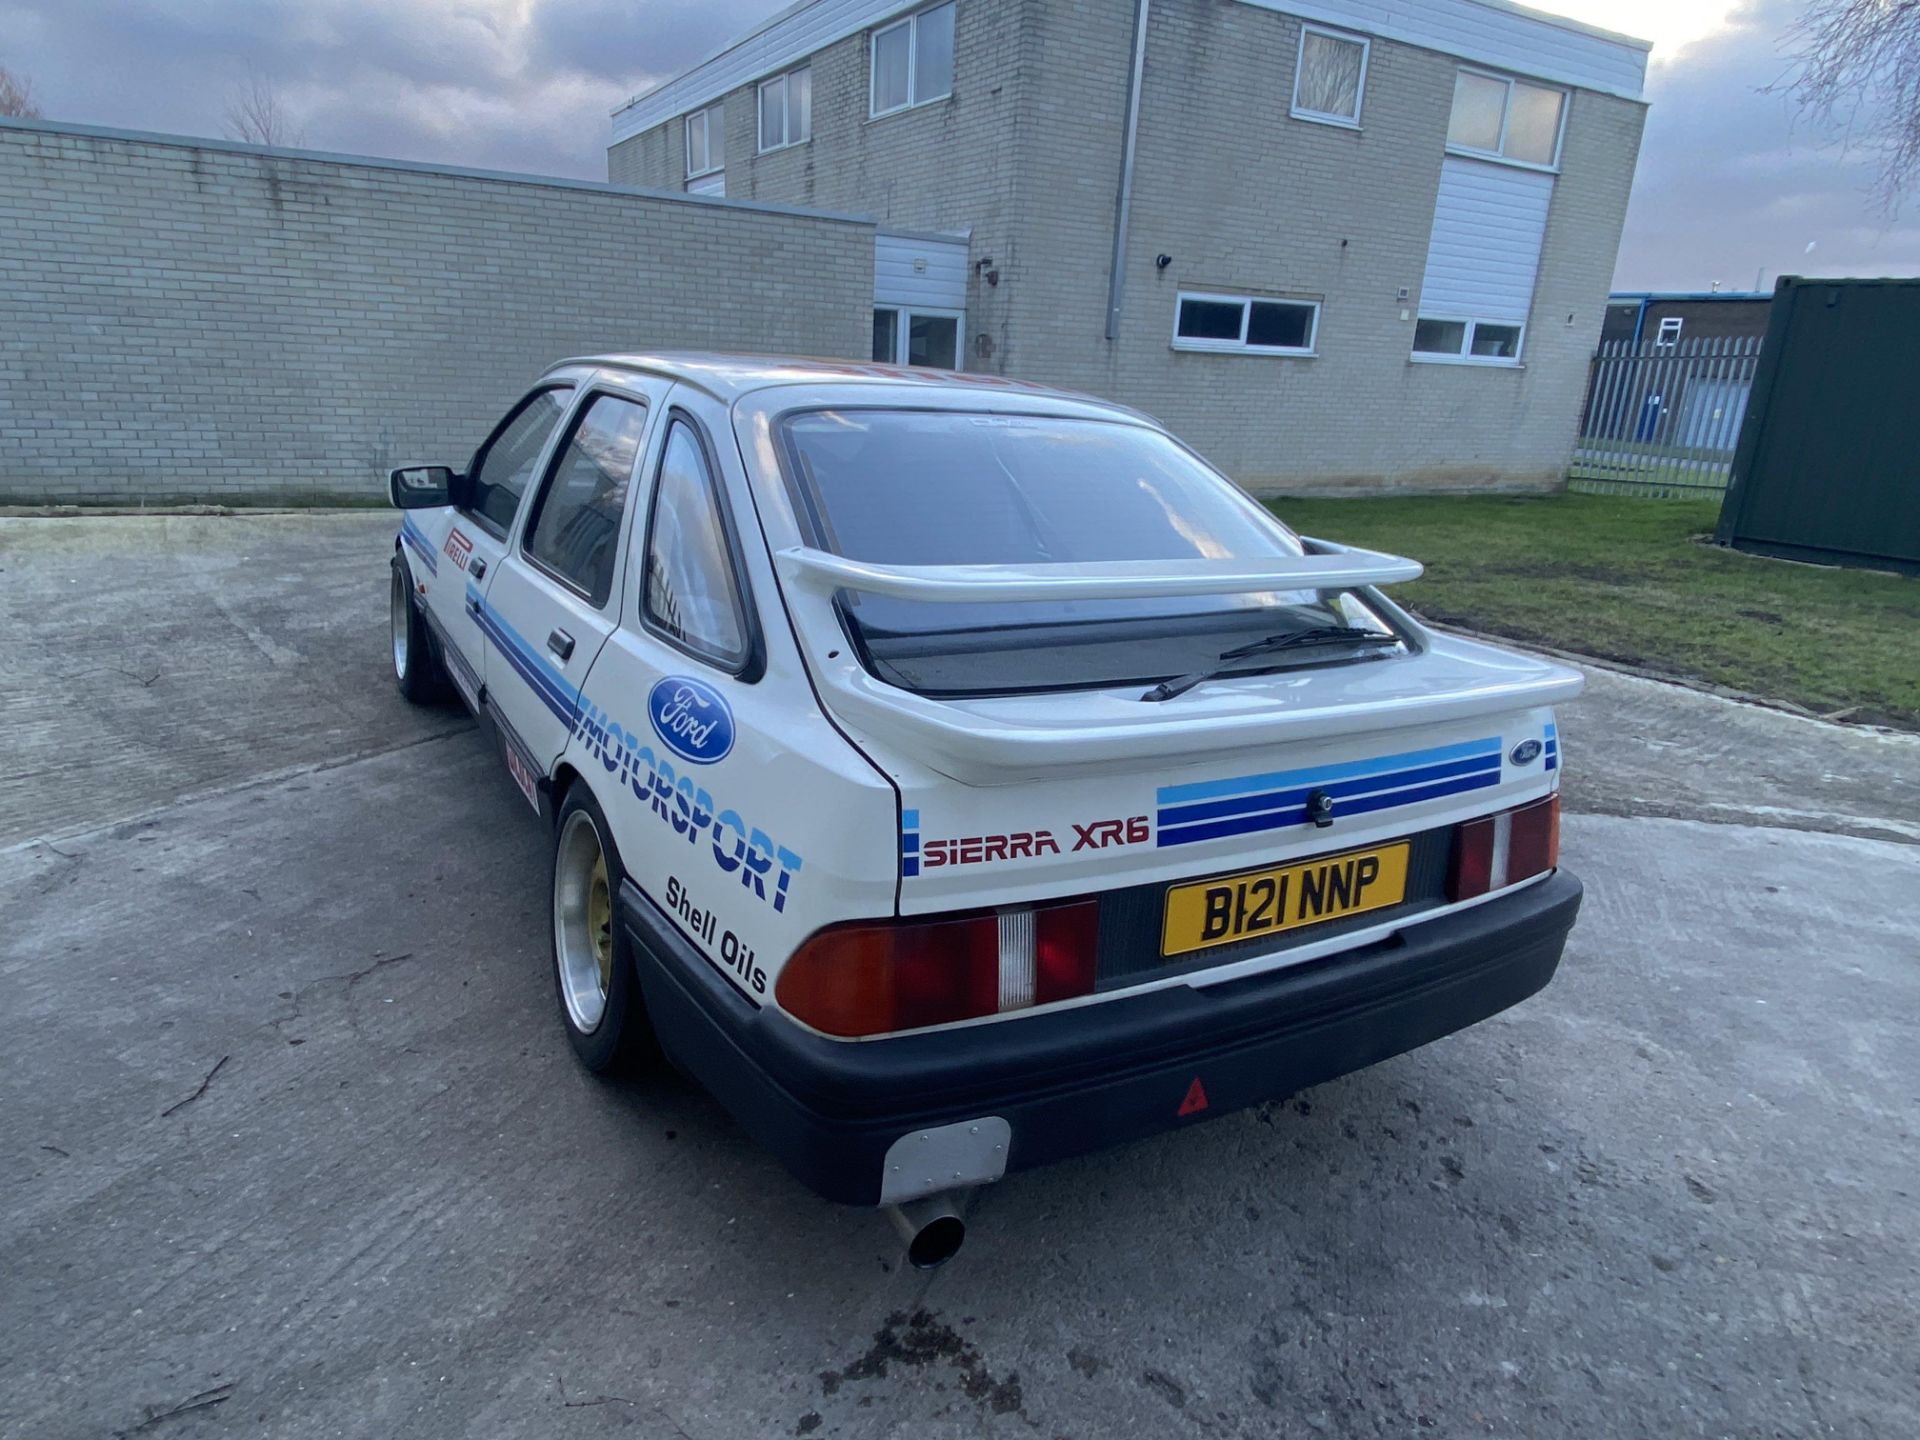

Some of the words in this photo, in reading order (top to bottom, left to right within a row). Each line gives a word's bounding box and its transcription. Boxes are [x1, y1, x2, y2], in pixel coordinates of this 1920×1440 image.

[443, 527, 473, 571] PIRELLI
[660, 685, 718, 749] Ford
[577, 704, 802, 913] MOTORSPORT
[923, 830, 1061, 867] SIERRA
[1071, 815, 1150, 852] XR6
[666, 875, 717, 946] Shell
[720, 930, 767, 994] Oils
[1201, 874, 1290, 941] B121
[1298, 855, 1380, 920] NNP
